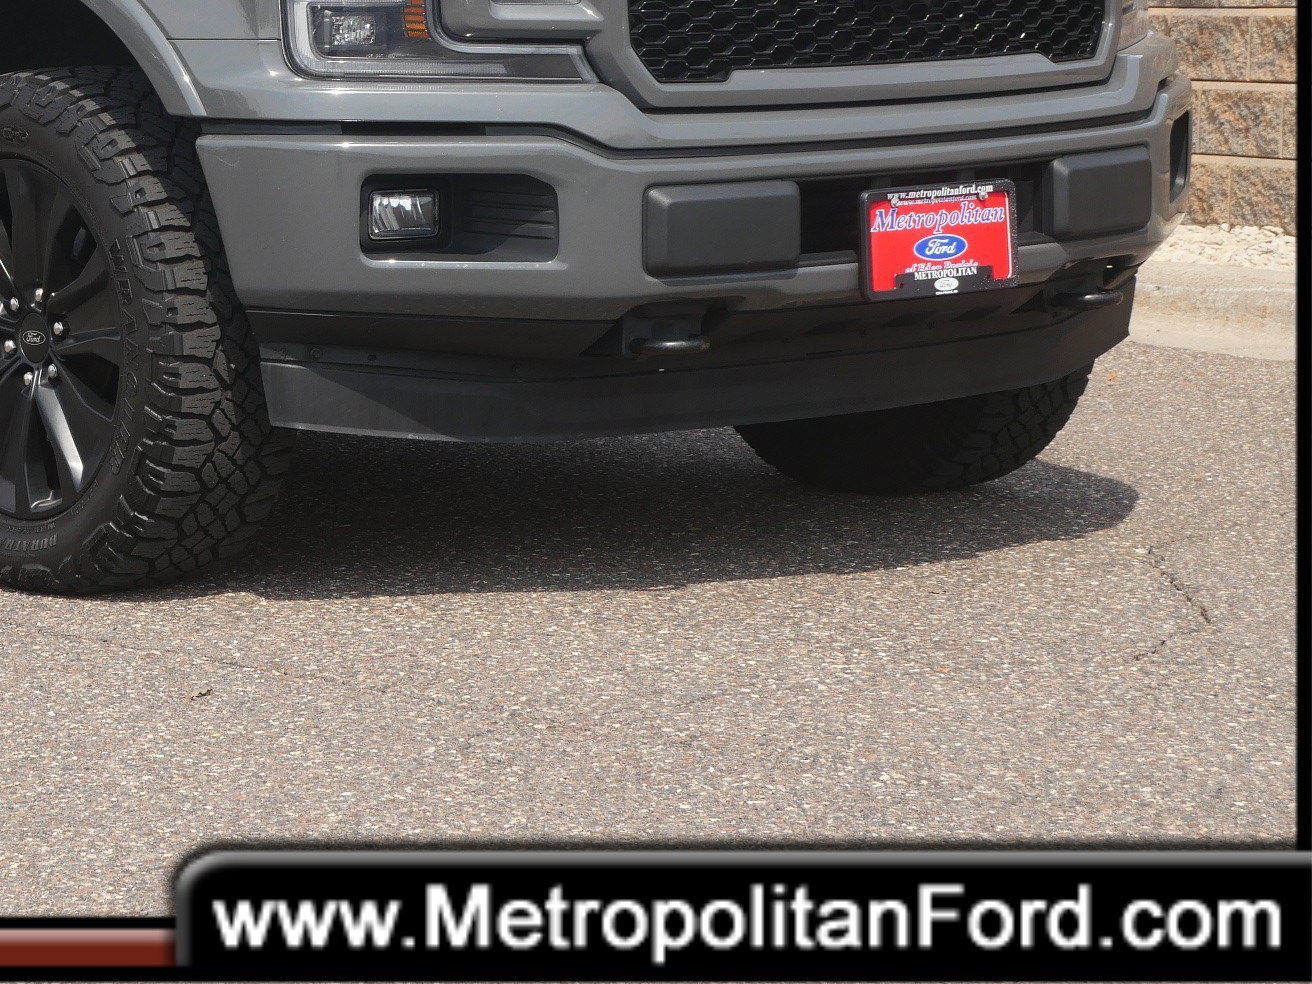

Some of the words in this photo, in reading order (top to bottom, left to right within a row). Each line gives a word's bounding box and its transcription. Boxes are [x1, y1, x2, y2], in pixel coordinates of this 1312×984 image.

[887, 185, 994, 201] www.metropolitanford.com
[870, 202, 1005, 234] Metropolitan
[924, 239, 956, 256] Ford
[914, 266, 978, 281] METROPOLITAN
